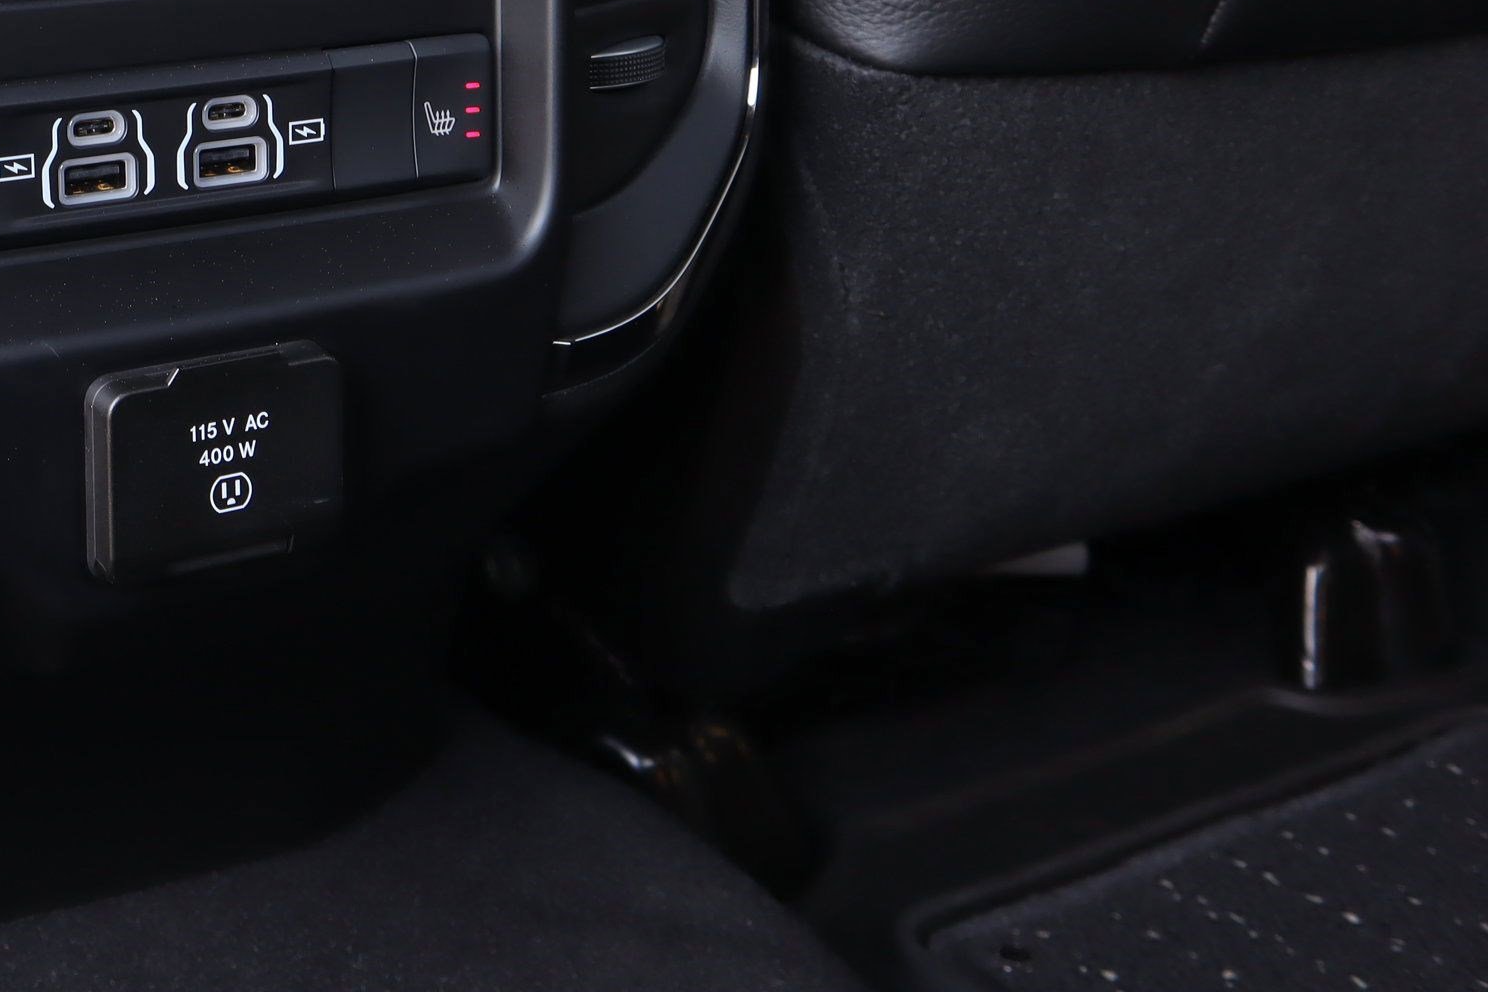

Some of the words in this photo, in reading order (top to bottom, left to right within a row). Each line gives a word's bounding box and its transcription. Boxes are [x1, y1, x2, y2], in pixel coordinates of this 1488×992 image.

[189, 421, 218, 442] 115
[221, 417, 236, 436] V
[244, 411, 269, 432] AC
[198, 445, 235, 467] 400
[238, 439, 257, 459] W
